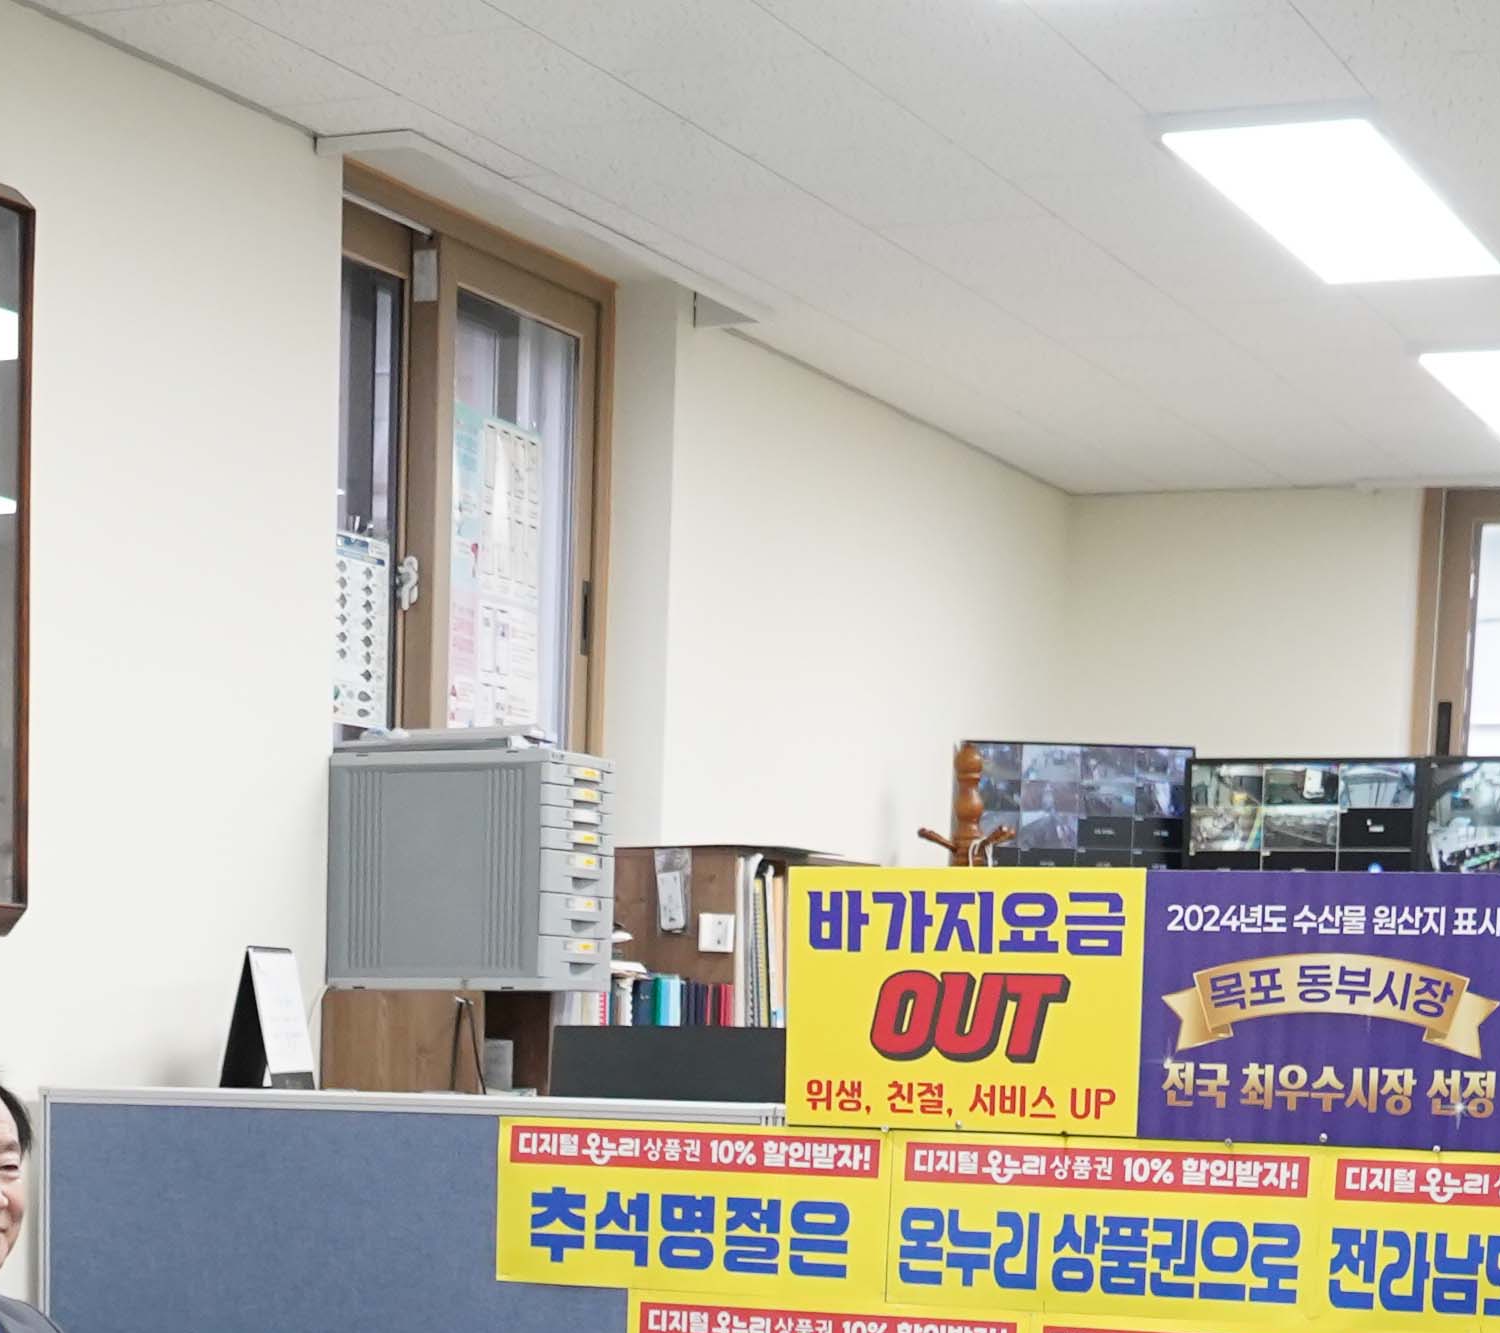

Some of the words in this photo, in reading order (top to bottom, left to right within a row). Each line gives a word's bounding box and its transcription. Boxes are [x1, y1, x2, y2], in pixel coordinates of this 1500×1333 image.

[807, 890, 1126, 957] 바가지요금
[1167, 903, 1288, 934] 2024년도
[1293, 905, 1366, 936] 수산물
[1372, 905, 1446, 937] 원산지
[1209, 967, 1286, 1010] 목포
[1296, 963, 1455, 1019] 동부시장
[869, 969, 1071, 1064] OUT
[806, 1079, 871, 1115] 위생,
[887, 1080, 953, 1117] 친절,
[969, 1082, 1056, 1120] 서비스
[1070, 1087, 1116, 1120] UP
[1162, 1061, 1230, 1109] 전국
[1239, 1062, 1418, 1116] 최우수시장
[1426, 1068, 1498, 1119] 선정
[518, 1131, 580, 1157] 디지털
[581, 1133, 641, 1165] 온누리
[643, 1138, 702, 1163] 상품권
[709, 1139, 757, 1166] 10%
[762, 1141, 872, 1172] 할인받자!
[913, 1148, 979, 1176] 디지털
[981, 1150, 1047, 1185] 온누리
[1049, 1154, 1114, 1182] 상품권
[1122, 1157, 1174, 1186] 10%
[1182, 1158, 1300, 1190] 할인받자!
[1344, 1166, 1417, 1193] 디지털
[1419, 1167, 1490, 1203] 온누리
[529, 1185, 851, 1280] 추석명절은
[898, 1206, 1041, 1291] 온누리
[1052, 1209, 1301, 1304] 상품권으로
[648, 1309, 710, 1333] 디지털
